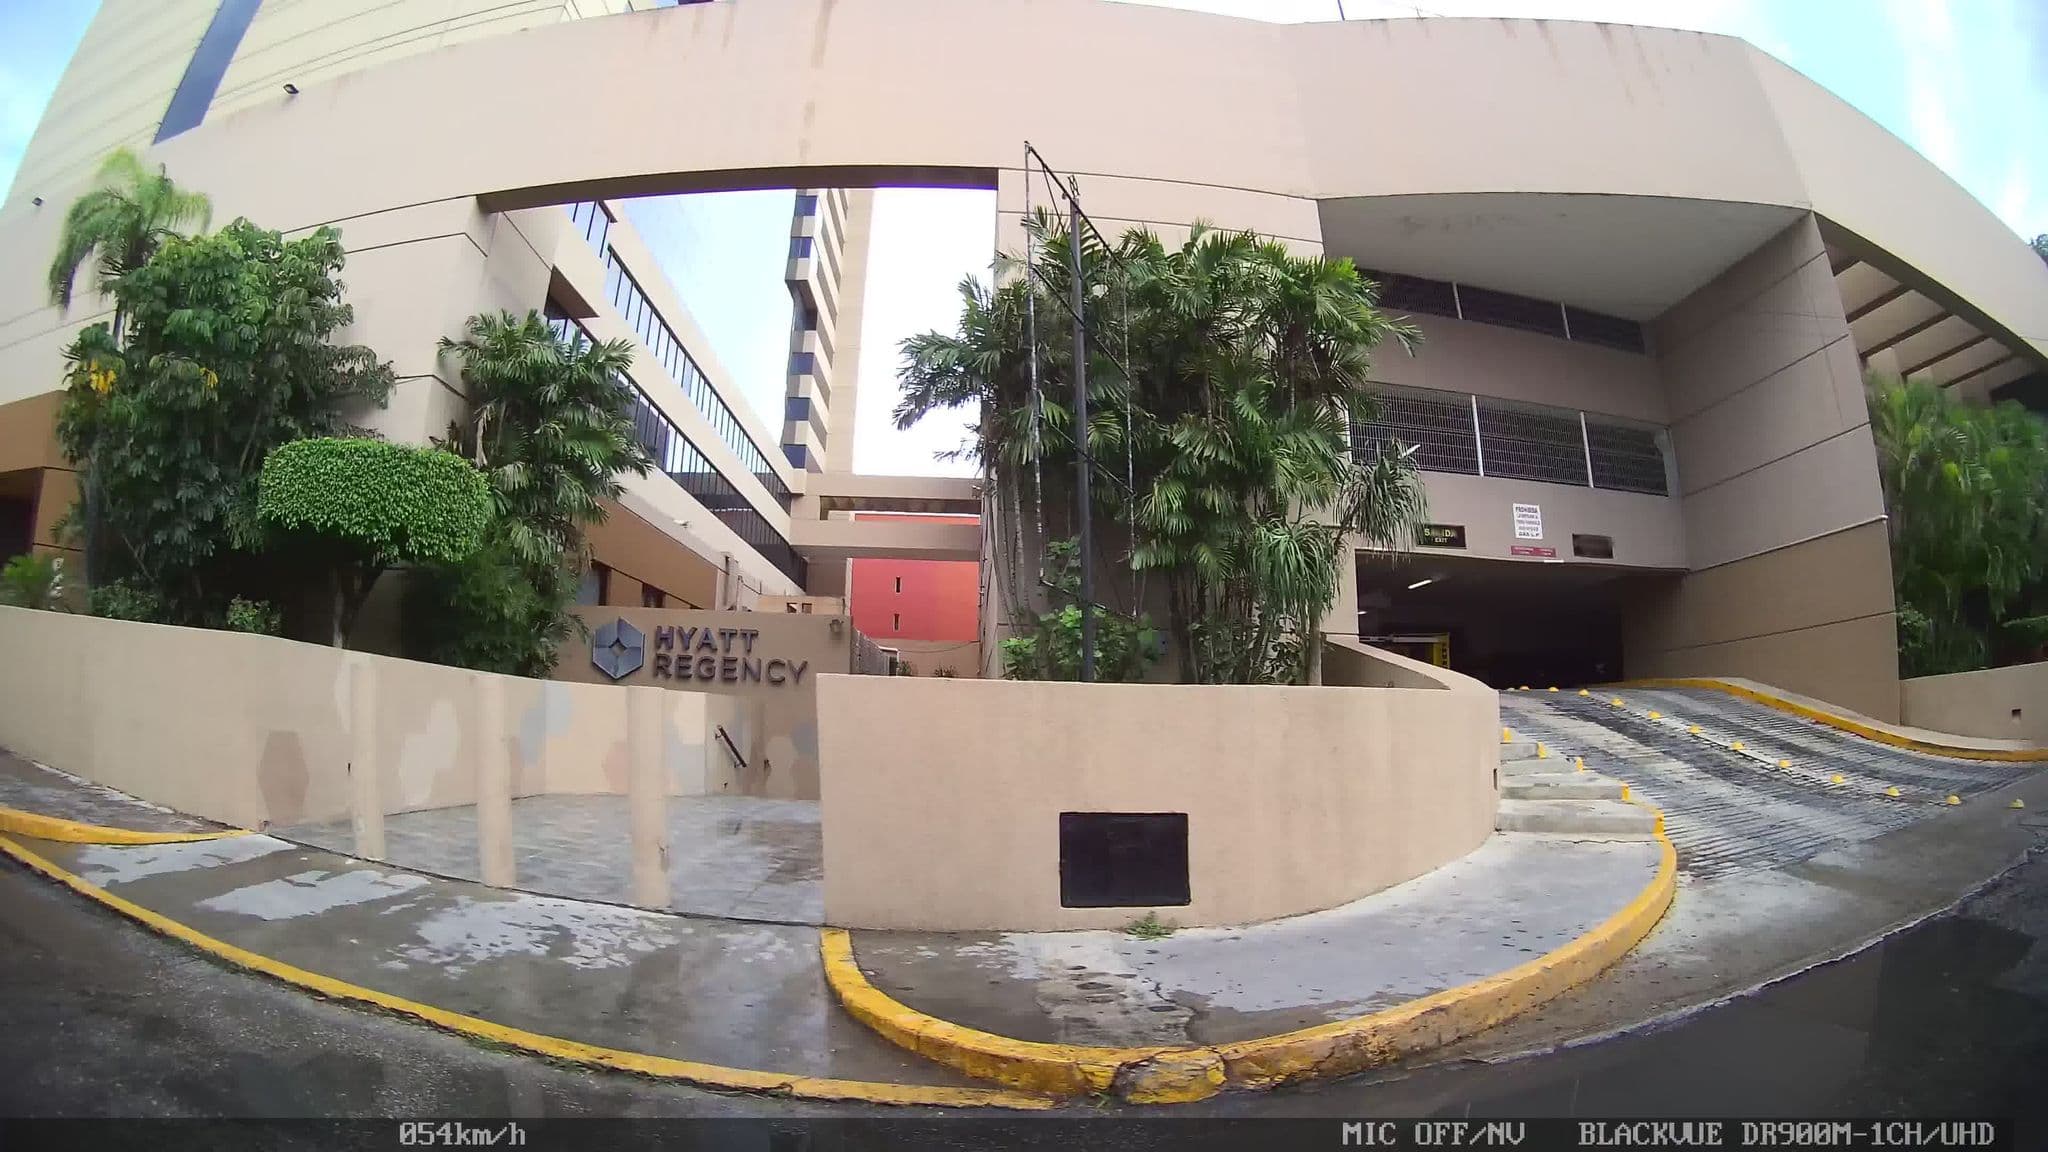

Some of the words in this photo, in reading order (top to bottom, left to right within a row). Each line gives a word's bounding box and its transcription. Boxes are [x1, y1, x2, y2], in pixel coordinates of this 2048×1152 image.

[1424, 528, 1459, 538] SID
[655, 625, 759, 653] HYATT
[654, 653, 808, 685] REGENCY
